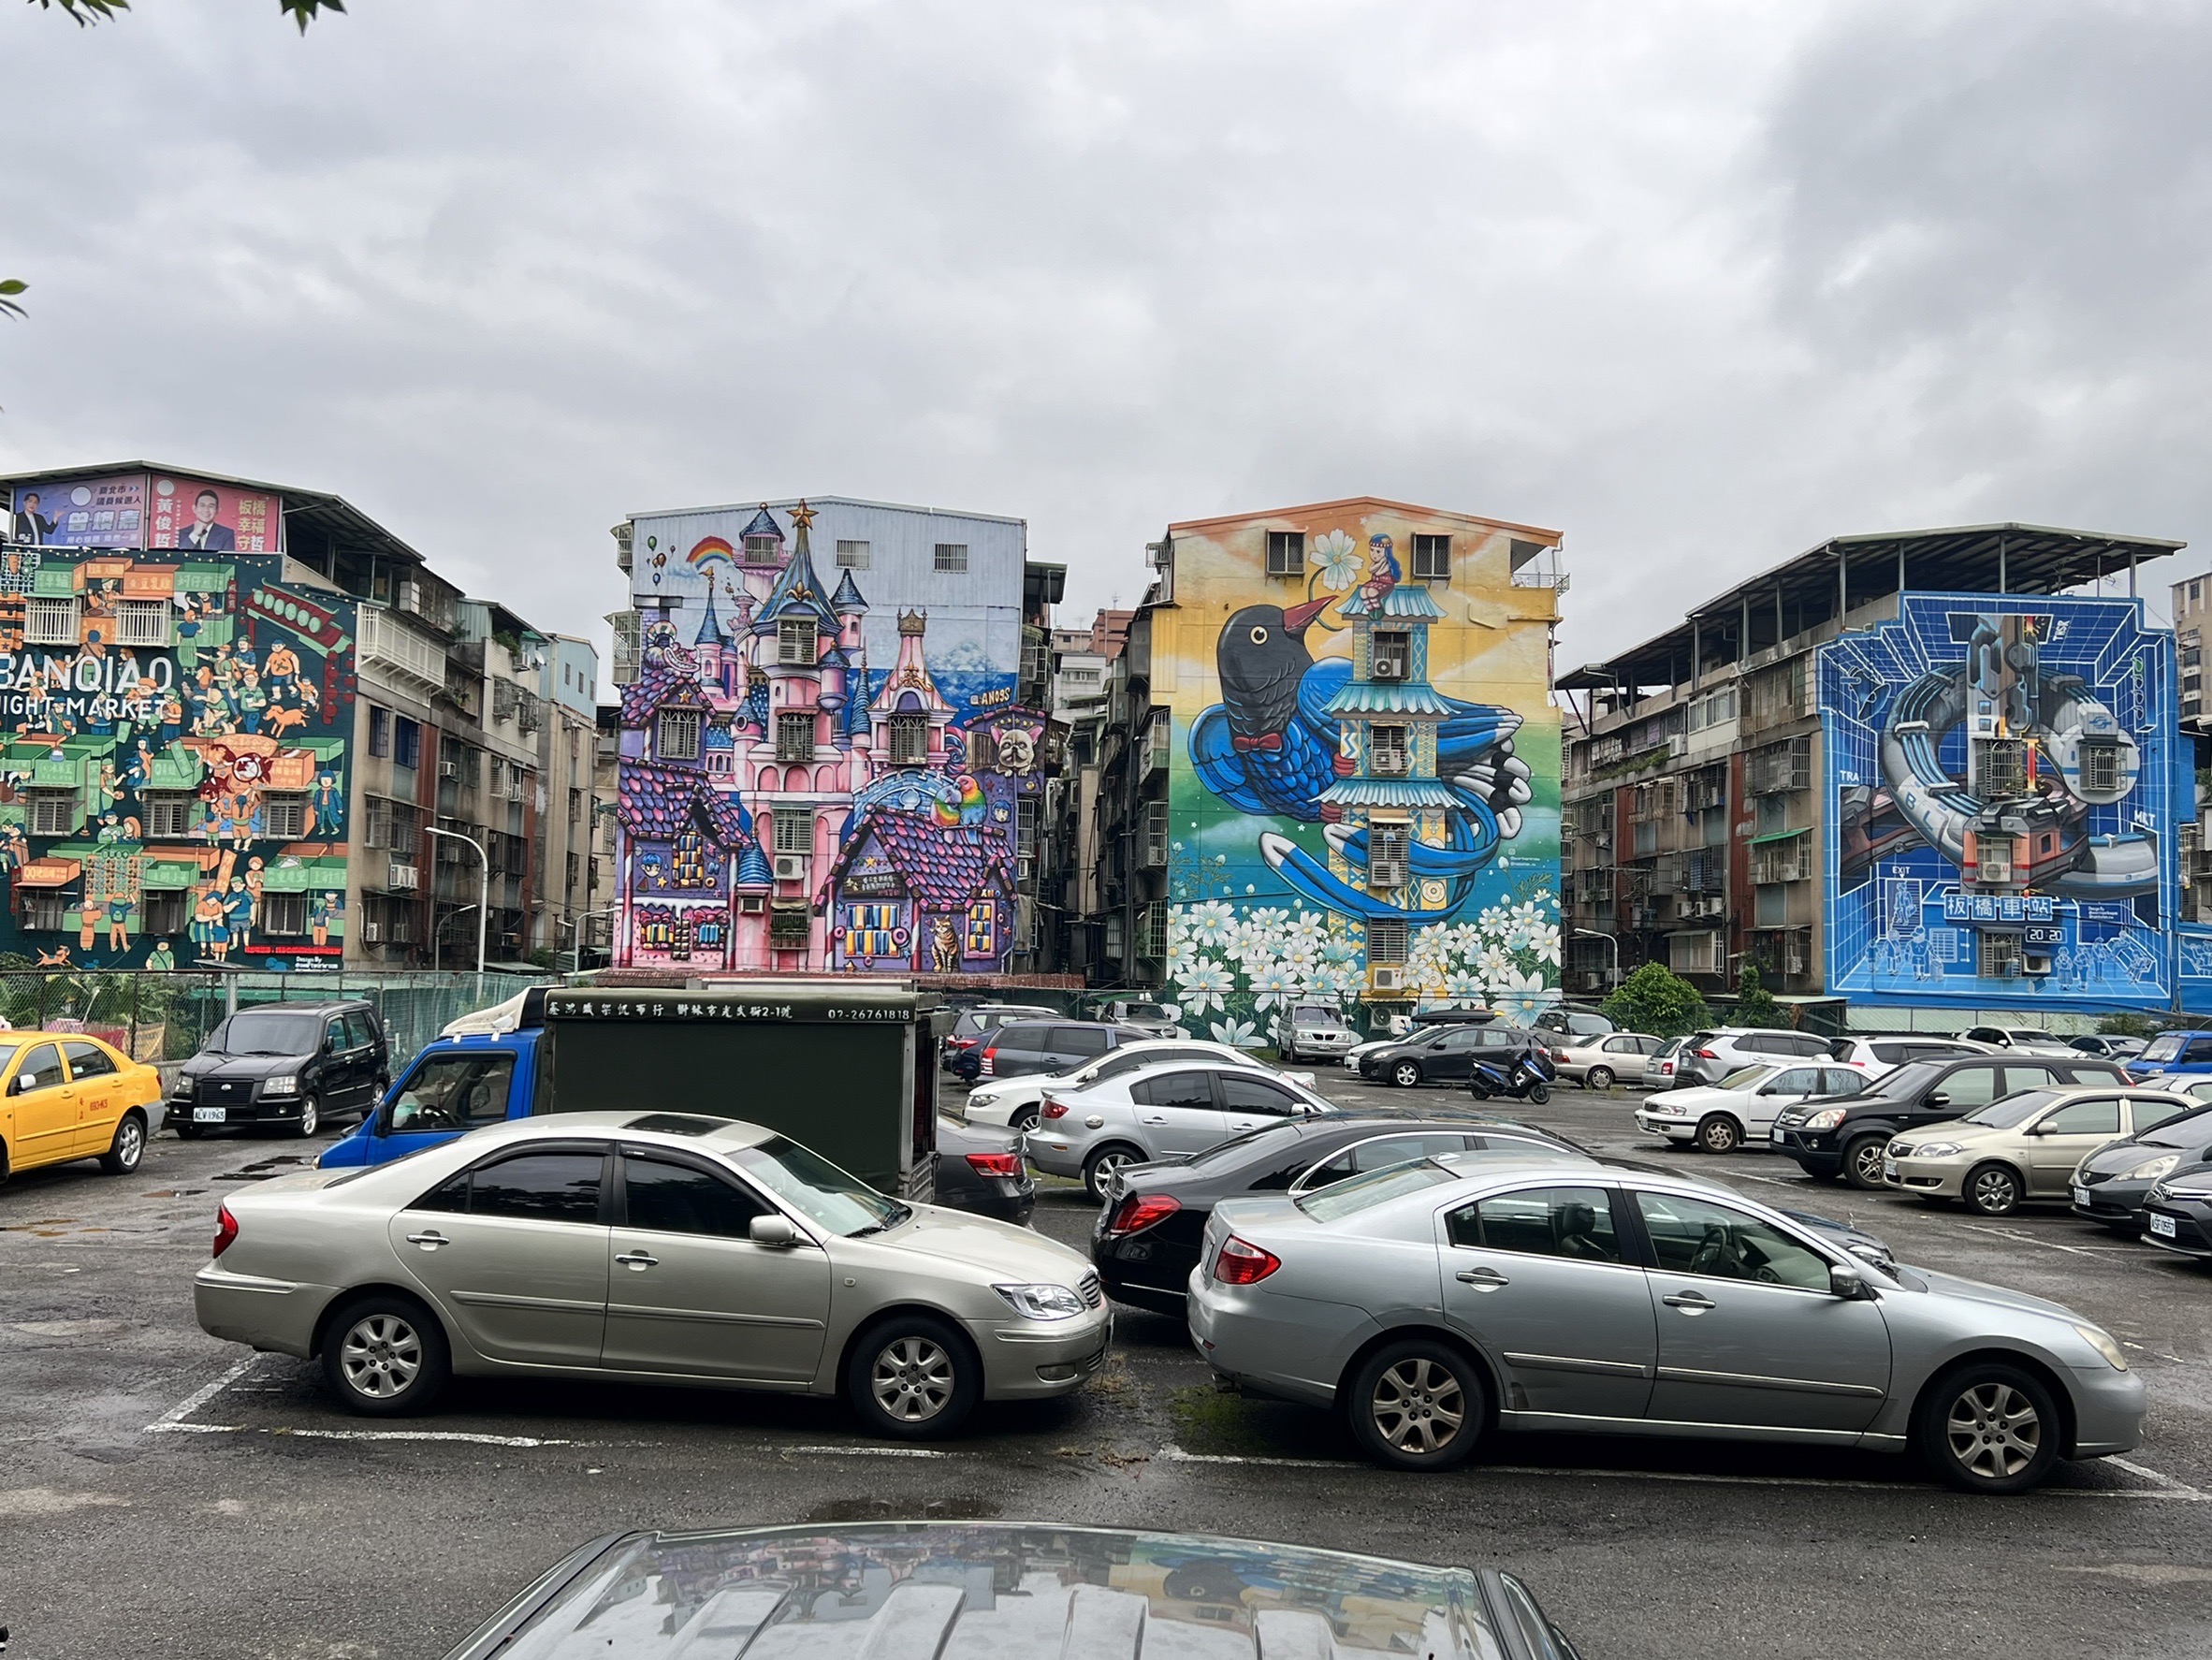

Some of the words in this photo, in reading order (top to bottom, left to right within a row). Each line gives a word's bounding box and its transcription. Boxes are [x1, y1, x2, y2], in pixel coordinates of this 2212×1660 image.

[239, 500, 266, 517] 板橋
[238, 517, 265, 534] 幸福
[0, 653, 172, 694] BANQIAO
[66, 697, 165, 721] MARKET
[1840, 770, 1859, 782] TRA
[2134, 809, 2156, 827] MRT
[1892, 866, 1911, 874] EXIT
[1947, 896, 2049, 917] 板橋車站
[827, 1010, 910, 1020] 02-26761818
